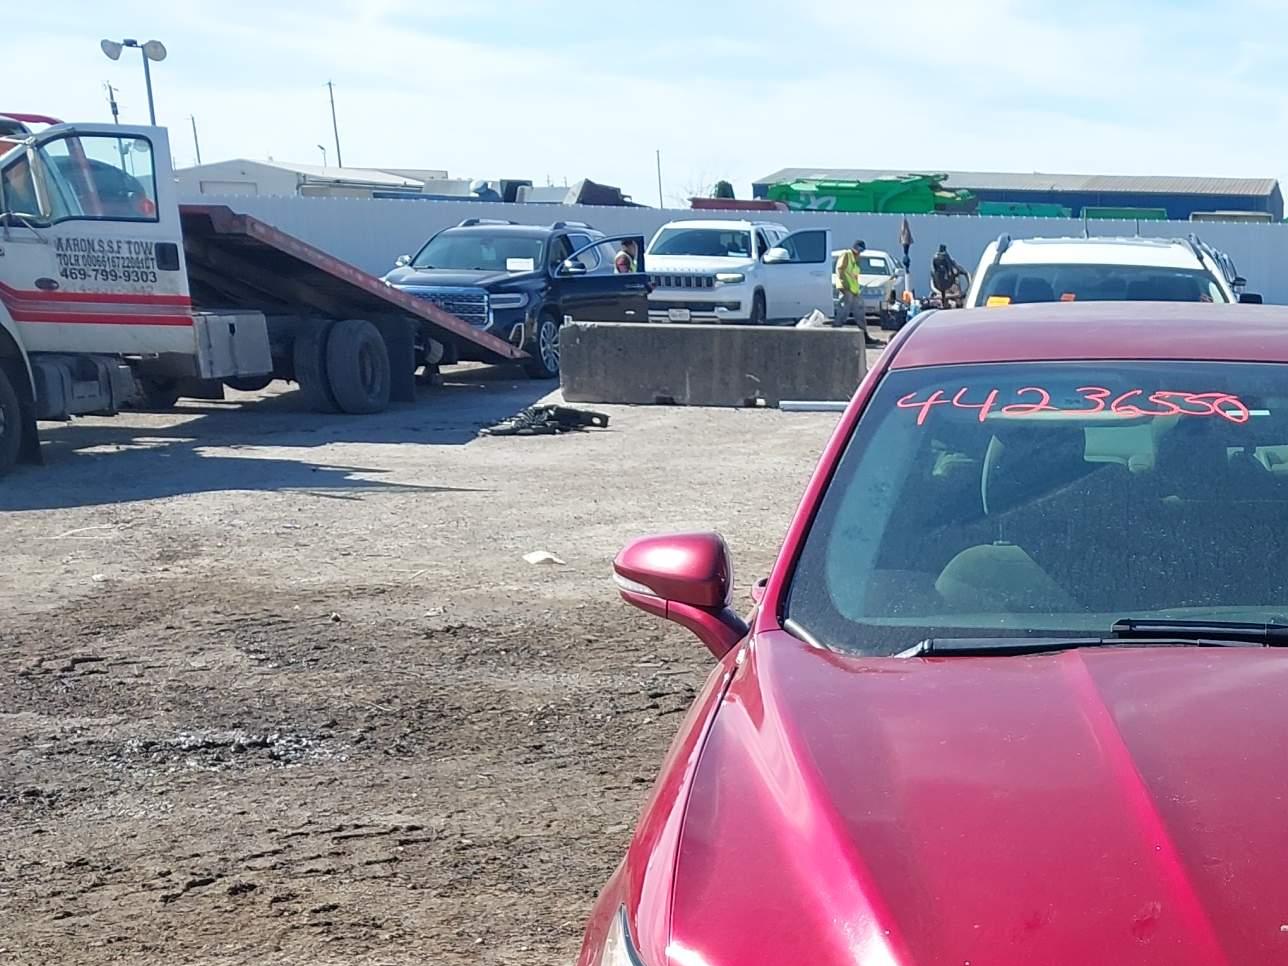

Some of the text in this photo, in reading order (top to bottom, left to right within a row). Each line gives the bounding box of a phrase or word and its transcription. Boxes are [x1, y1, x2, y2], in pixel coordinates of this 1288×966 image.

[127, 241, 153, 255] TOW
[60, 267, 157, 283] 469-799-9303
[897, 388, 1247, 425] 44236550
